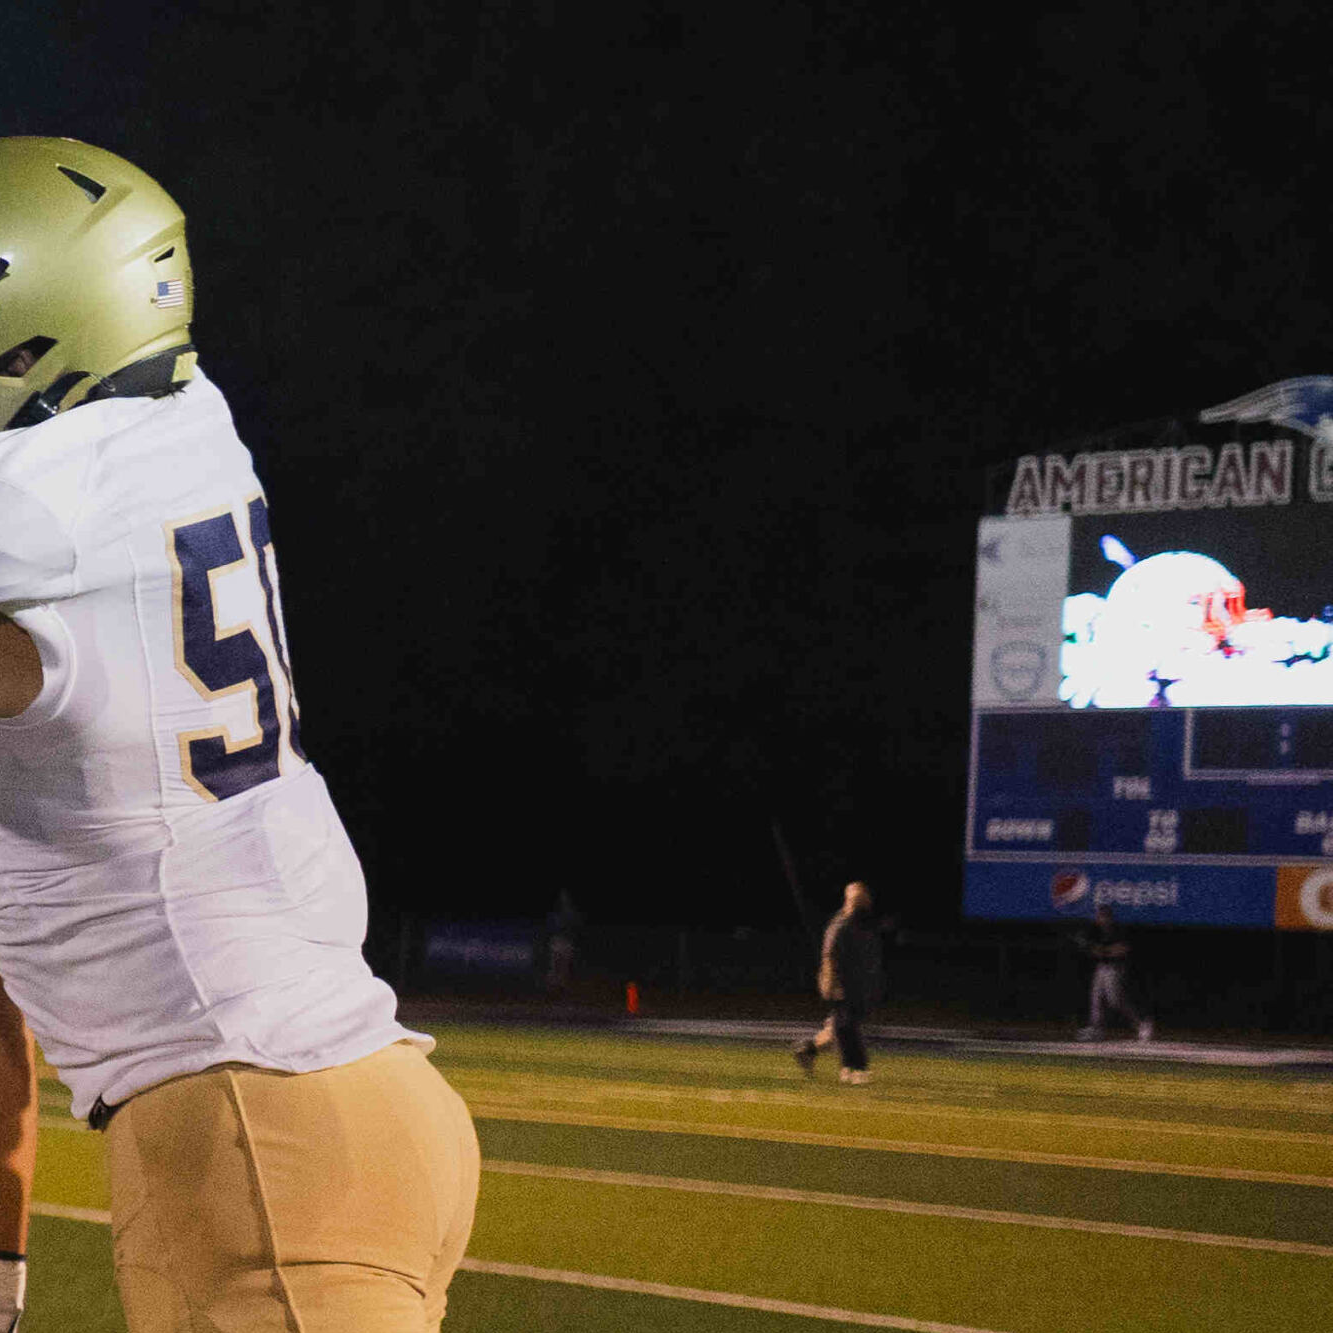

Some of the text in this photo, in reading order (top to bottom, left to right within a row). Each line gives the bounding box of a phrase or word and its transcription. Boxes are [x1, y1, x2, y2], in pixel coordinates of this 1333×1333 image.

[1005, 439, 1293, 516] AMERICAN
[163, 491, 309, 802] 5
[1094, 877, 1179, 913] pepsi
